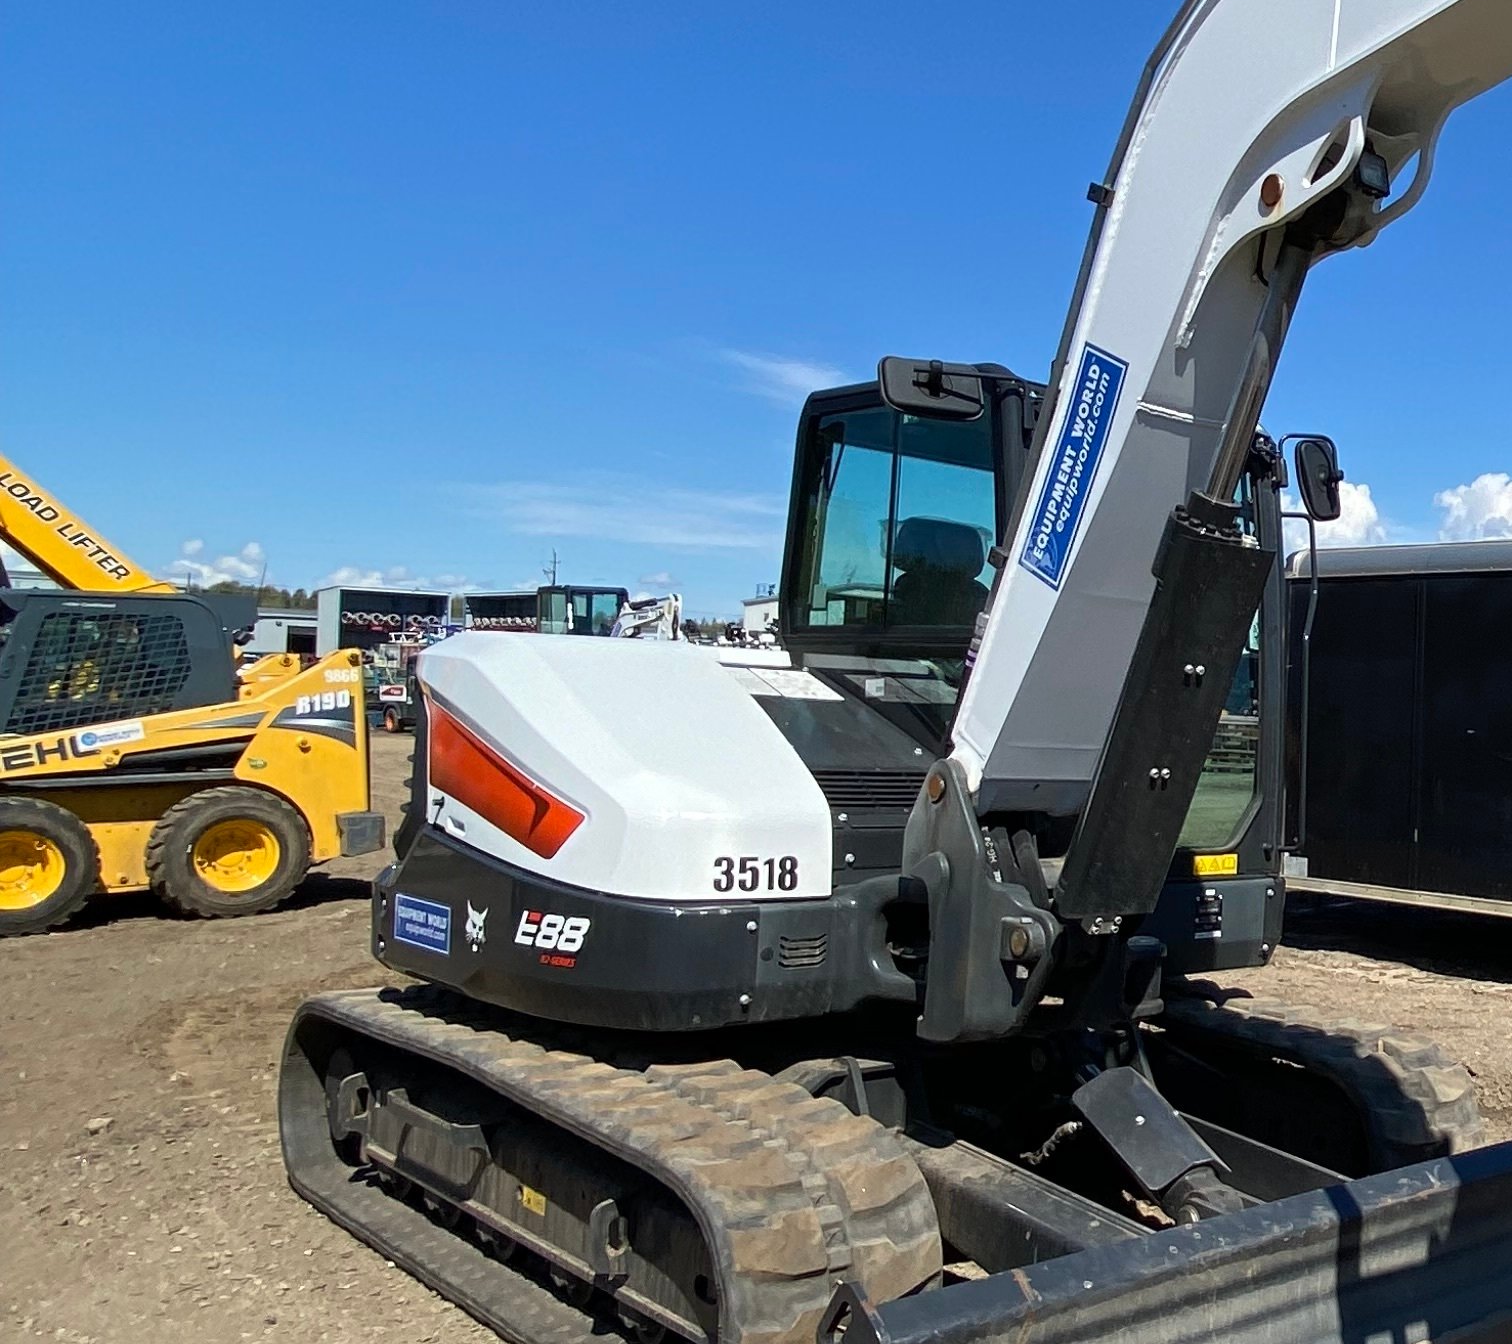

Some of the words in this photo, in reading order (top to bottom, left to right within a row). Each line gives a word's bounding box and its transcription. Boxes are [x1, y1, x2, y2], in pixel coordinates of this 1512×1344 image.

[1033, 444, 1077, 561] EQUIPMENT
[1071, 364, 1101, 439] WORLD
[1055, 371, 1110, 534] equipworld.com
[0, 473, 59, 522] LOAD
[56, 523, 131, 580] LIFTER
[713, 855, 799, 893] 3518
[514, 909, 591, 953] E88
